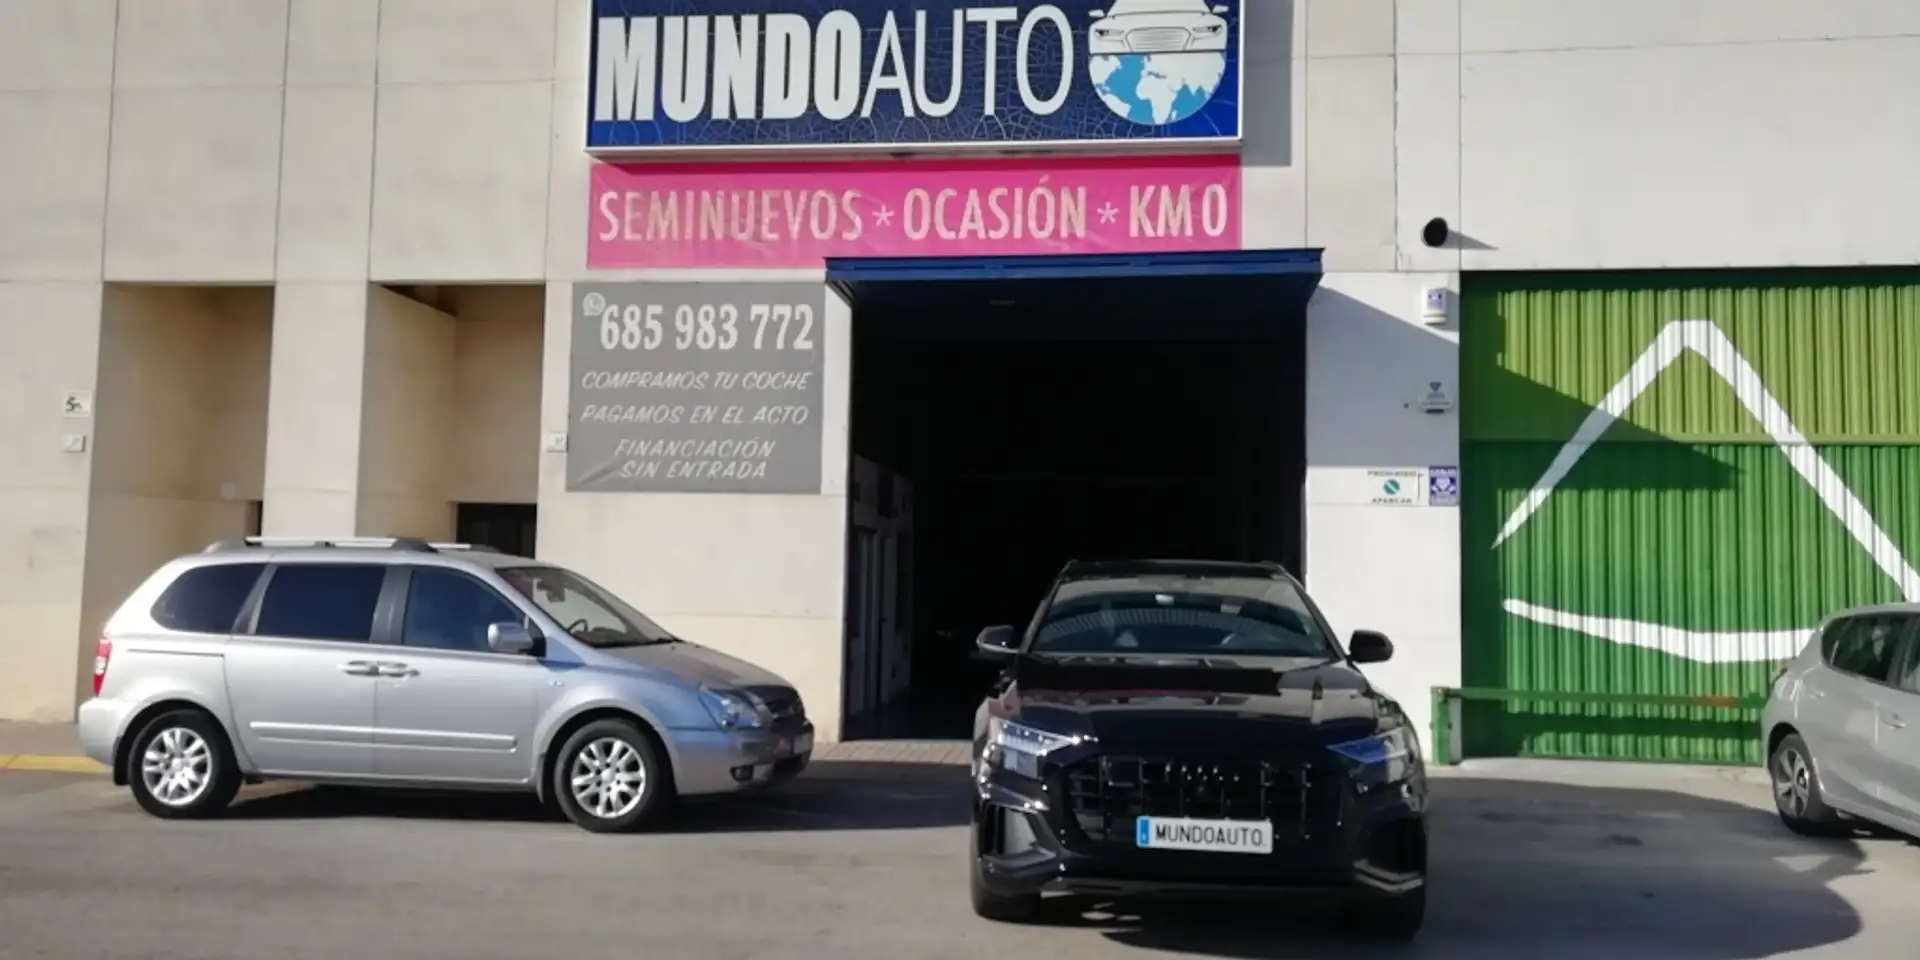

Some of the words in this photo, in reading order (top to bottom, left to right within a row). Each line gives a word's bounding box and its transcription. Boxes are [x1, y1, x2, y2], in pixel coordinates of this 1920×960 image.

[594, 4, 1074, 122] MUNDOAUTO
[599, 188, 864, 241] SEMINUEVOS
[902, 175, 1087, 240] OCASIÓN
[600, 303, 664, 350] 685
[674, 303, 738, 350] 983
[750, 303, 814, 350] 772
[581, 371, 711, 391] COMPRAMOS
[714, 371, 738, 391] TU
[742, 371, 814, 391] COCHE
[579, 404, 686, 425] PAGAMOS
[689, 405, 718, 424] EN
[722, 405, 744, 424] EL
[752, 405, 809, 426] ACTO
[614, 437, 777, 458] FINANCIACIÓN
[619, 460, 662, 479] SIN
[666, 460, 768, 480] ENTRADA
[1155, 823, 1264, 847] MUNDOAUTO
